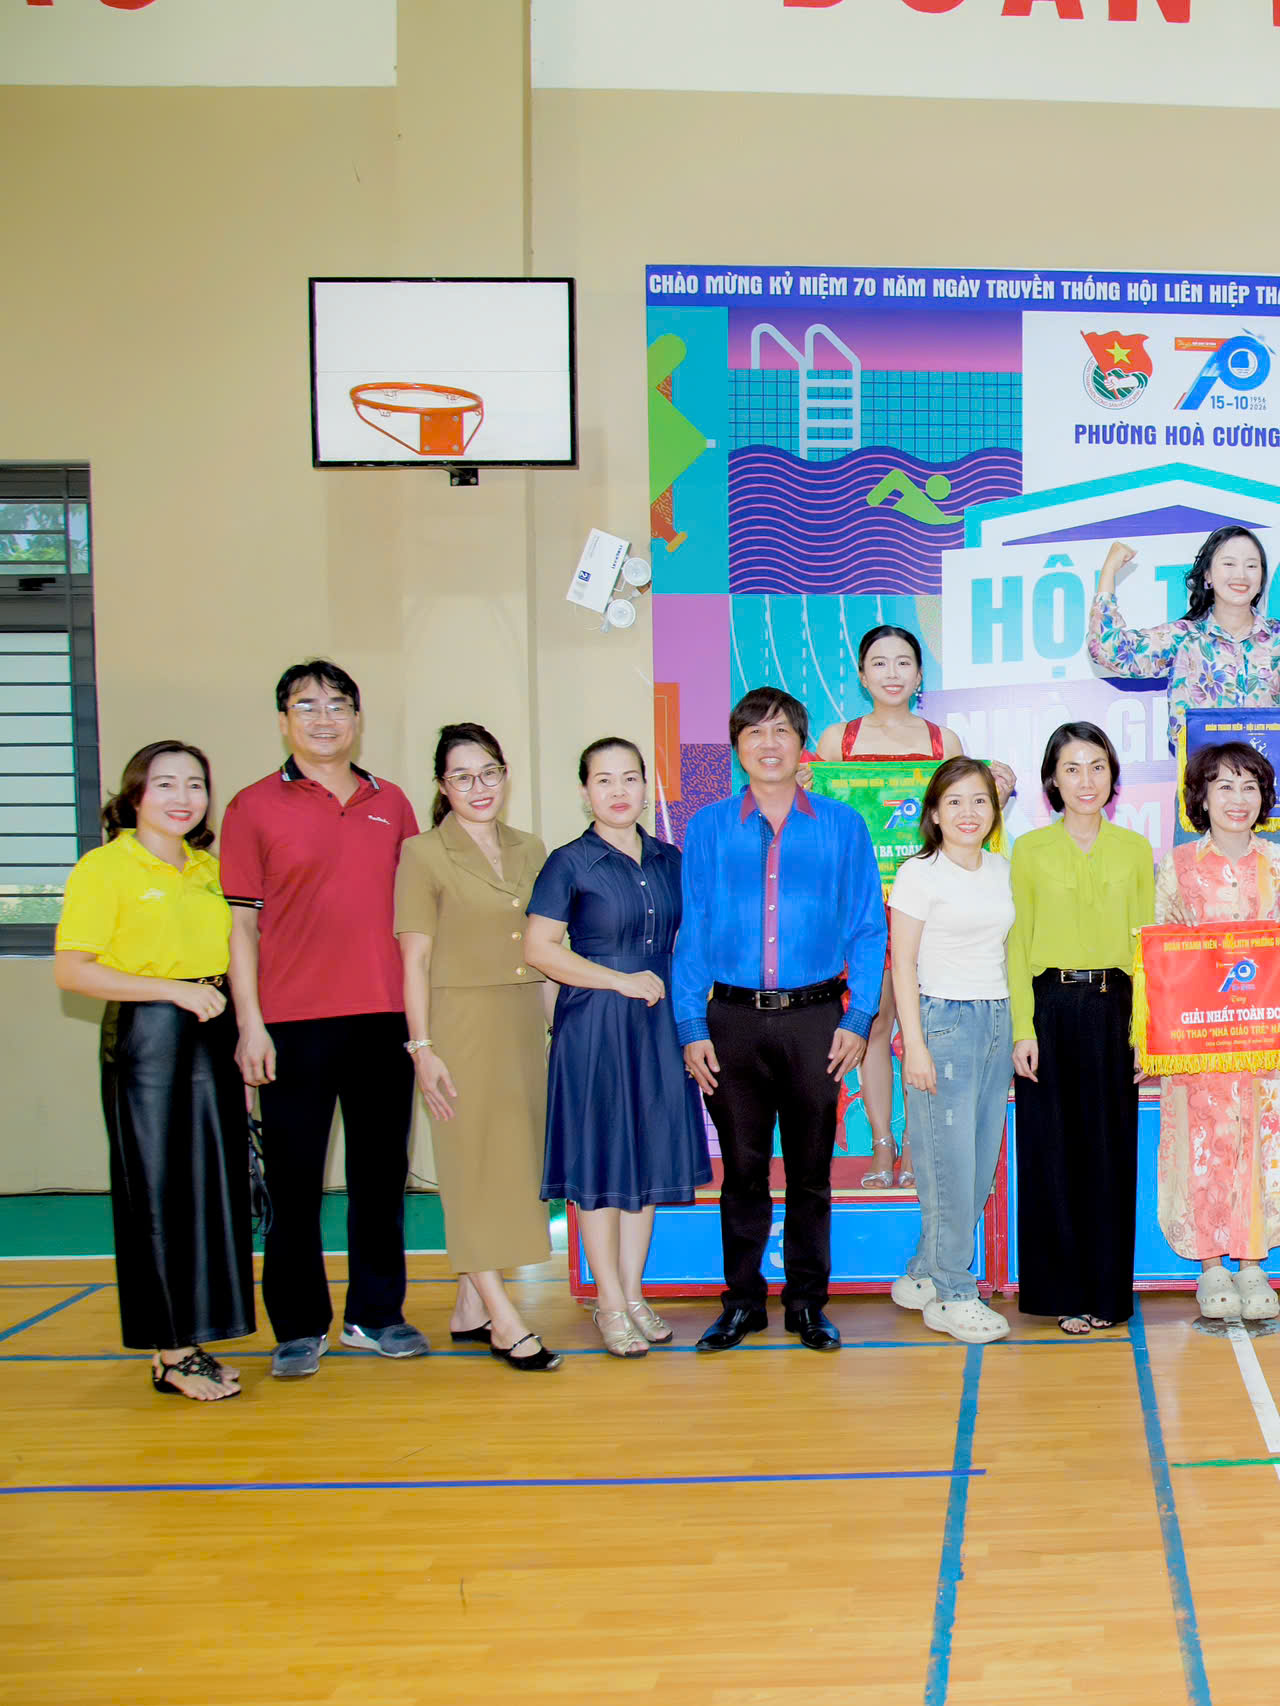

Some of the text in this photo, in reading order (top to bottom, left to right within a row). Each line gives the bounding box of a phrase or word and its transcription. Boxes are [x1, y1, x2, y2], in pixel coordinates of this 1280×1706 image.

[649, 271, 699, 294] CHÀO
[705, 272, 763, 295] MỪNG
[769, 271, 793, 296] KỶ
[799, 272, 848, 300] NIỆM
[853, 277, 877, 297] 70
[883, 274, 926, 297] NĂM
[932, 275, 981, 298] NGÀY
[986, 273, 1055, 300] TRUYỀN
[1061, 274, 1121, 302] THỐNG
[1127, 279, 1158, 306] HỘI
[1164, 279, 1203, 304] LIÊN
[1209, 281, 1250, 308] HIỆP
[1074, 420, 1280, 448] PHƯỜNG HOÀ CƯỜNG
[971, 553, 1103, 678] HỘ
[1180, 1007, 1205, 1025] GIẢI
[1206, 1004, 1235, 1024] NHẤT
[1235, 1004, 1265, 1021] TOÀN
[1186, 1028, 1208, 1039] THAO
